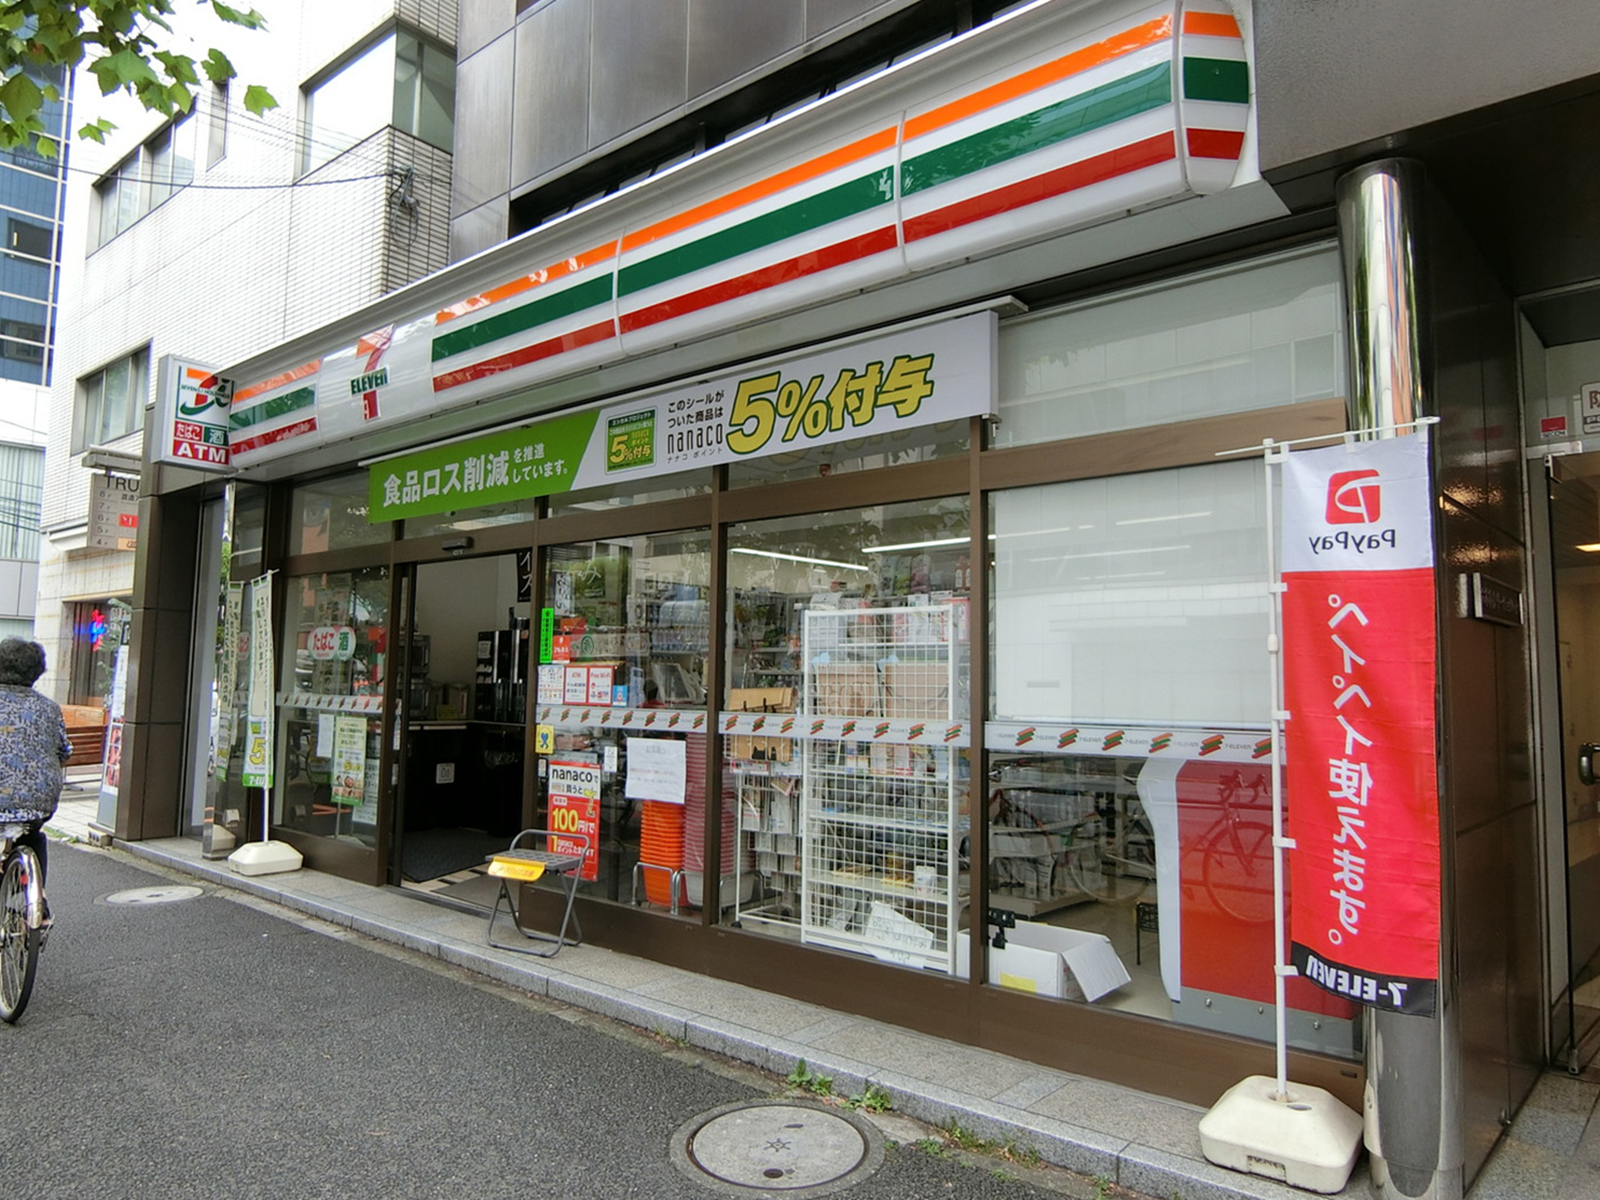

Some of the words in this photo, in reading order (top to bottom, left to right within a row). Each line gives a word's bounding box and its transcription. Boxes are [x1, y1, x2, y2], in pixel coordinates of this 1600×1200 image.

[668, 389, 725, 414] このシールが
[725, 354, 936, 455] 5%付与
[667, 406, 725, 429] ついた商品は
[176, 423, 201, 441] たばこ
[209, 428, 225, 445] 酒
[667, 423, 724, 455] nanaco
[177, 442, 226, 463] ATM
[513, 443, 546, 464] を推進
[610, 435, 652, 463] 5%付与
[667, 455, 688, 465] ナナコ
[692, 446, 723, 459] ポイント
[383, 450, 510, 508] 食品ロス削減
[512, 459, 569, 484] しています。
[313, 632, 335, 651] たばこ
[337, 632, 350, 651] 酒
[566, 784, 583, 795] 買うと
